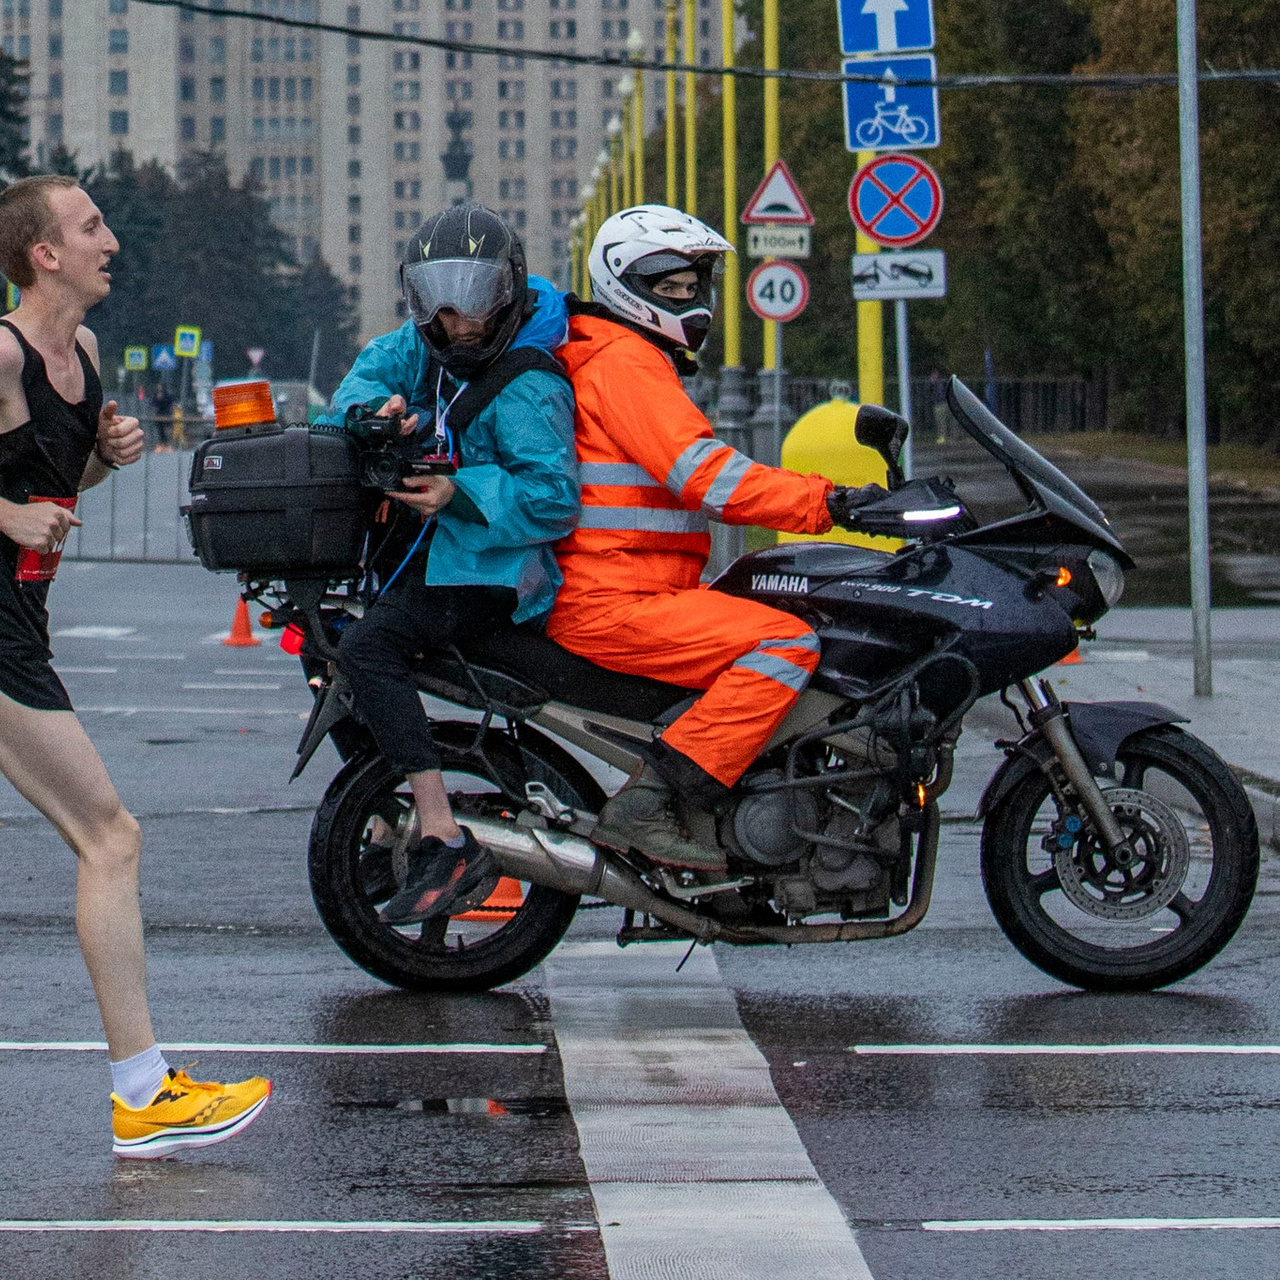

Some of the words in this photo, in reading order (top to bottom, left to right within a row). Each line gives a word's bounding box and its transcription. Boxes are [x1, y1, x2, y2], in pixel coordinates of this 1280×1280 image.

[758, 279, 796, 304] 40
[751, 574, 808, 593] YAMAHA
[907, 588, 994, 610] TDM
